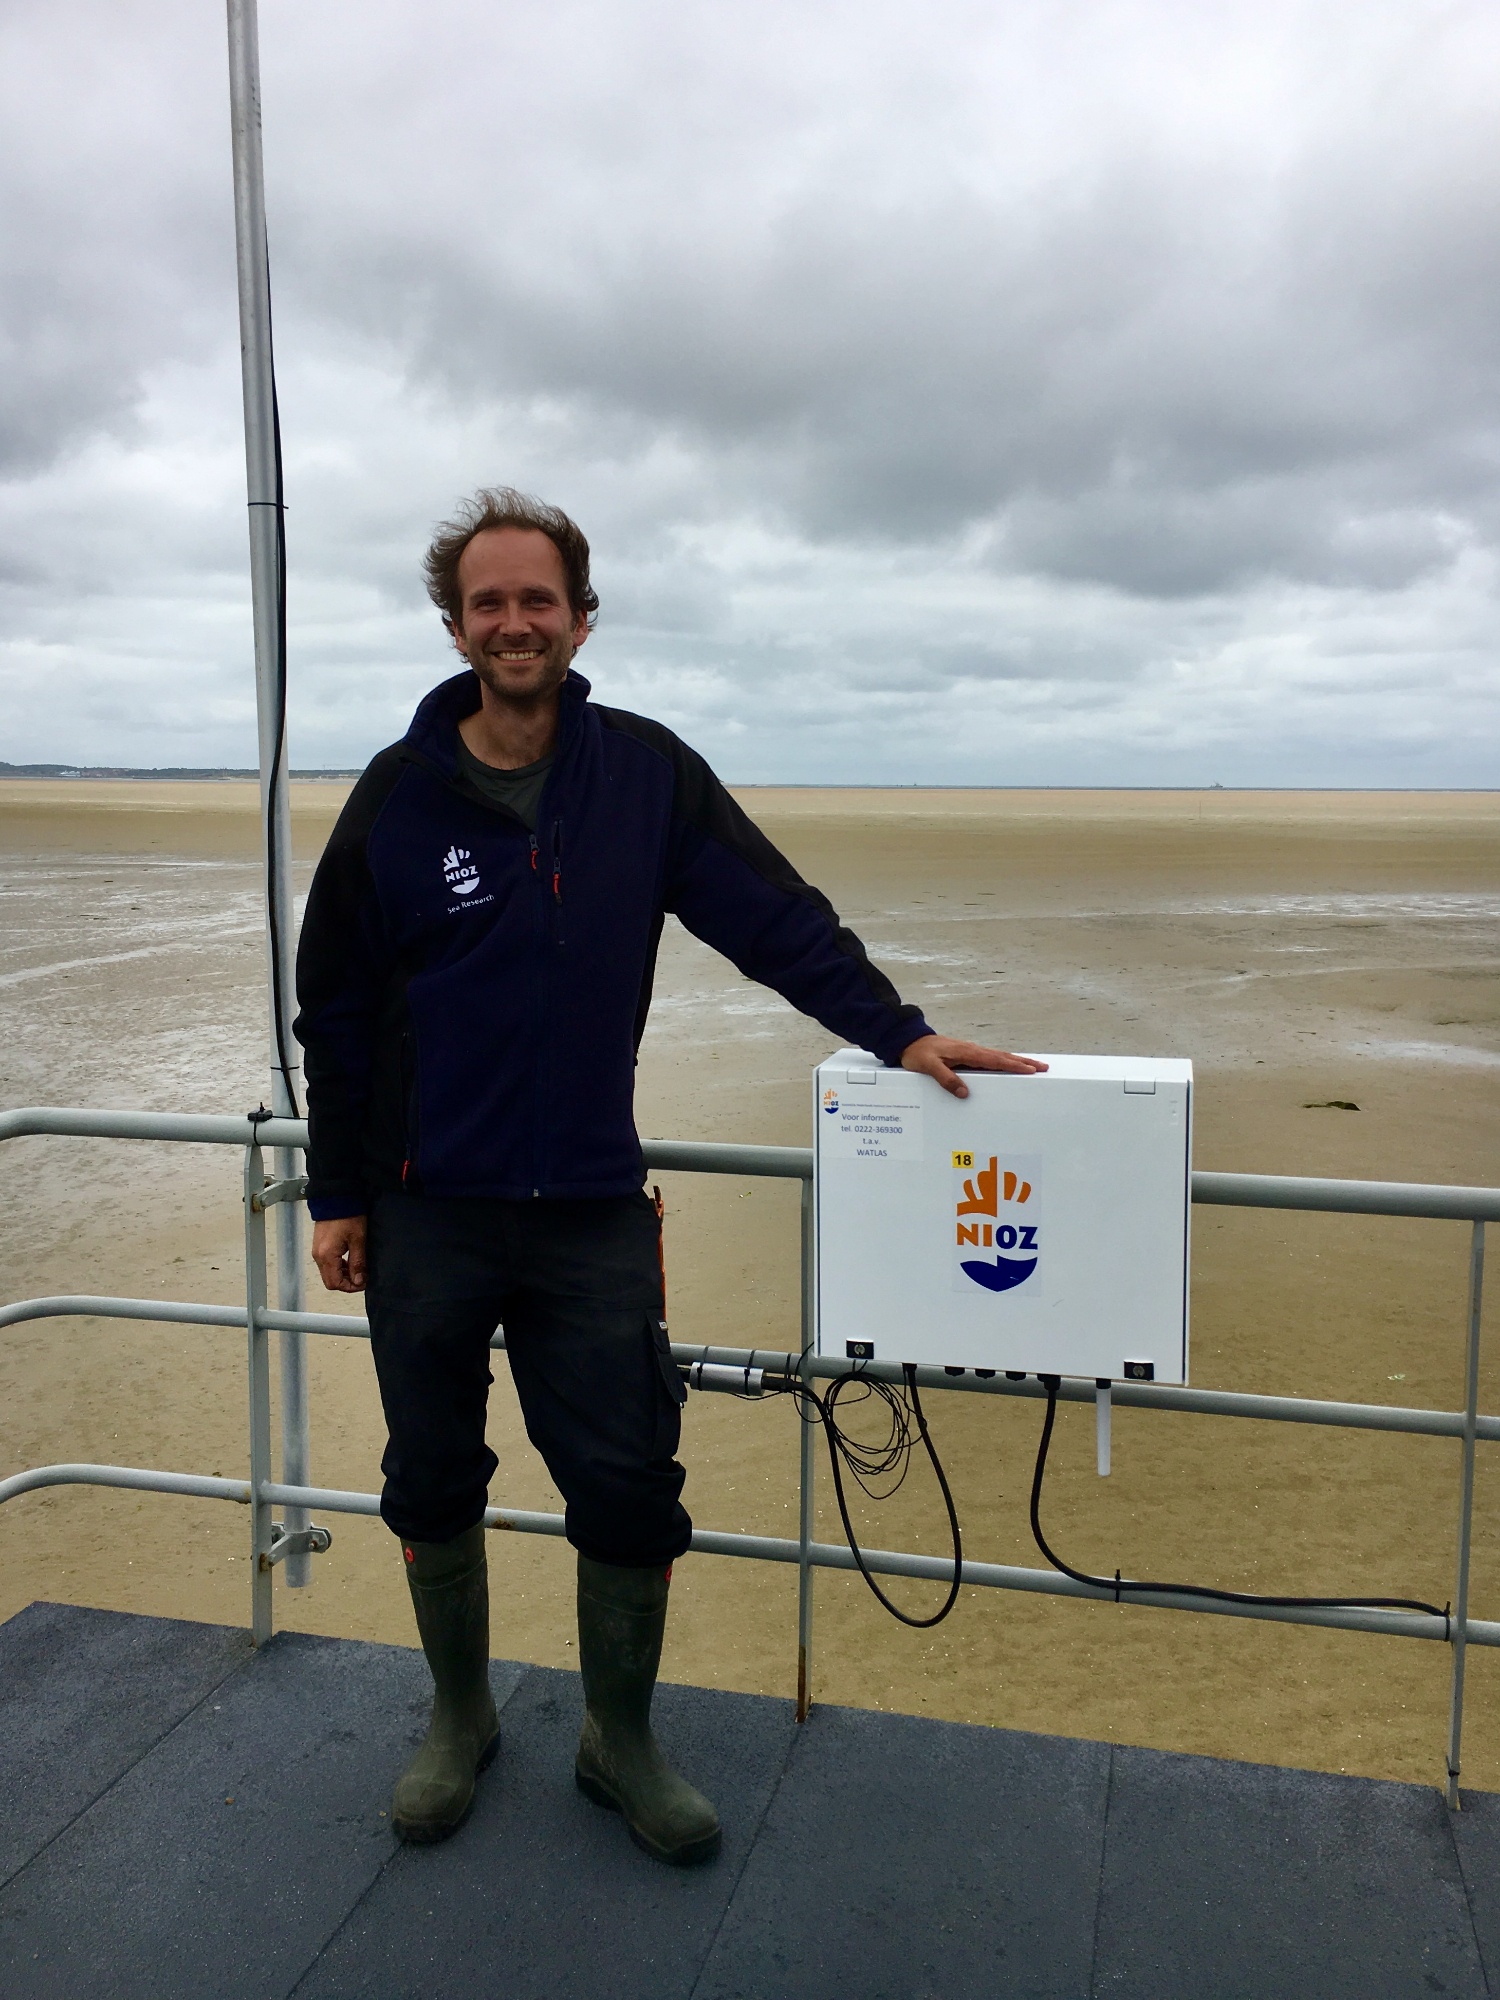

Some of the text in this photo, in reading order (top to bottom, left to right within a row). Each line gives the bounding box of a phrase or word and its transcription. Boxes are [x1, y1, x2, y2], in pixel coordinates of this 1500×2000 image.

[445, 865, 478, 882] NIOZ
[447, 894, 494, 914] Sea Research
[842, 1113, 901, 1122] Voor informatie:
[854, 1125, 903, 1134] 0222-369300
[955, 1154, 972, 1166] 18
[956, 1222, 1038, 1250] NIOZ
